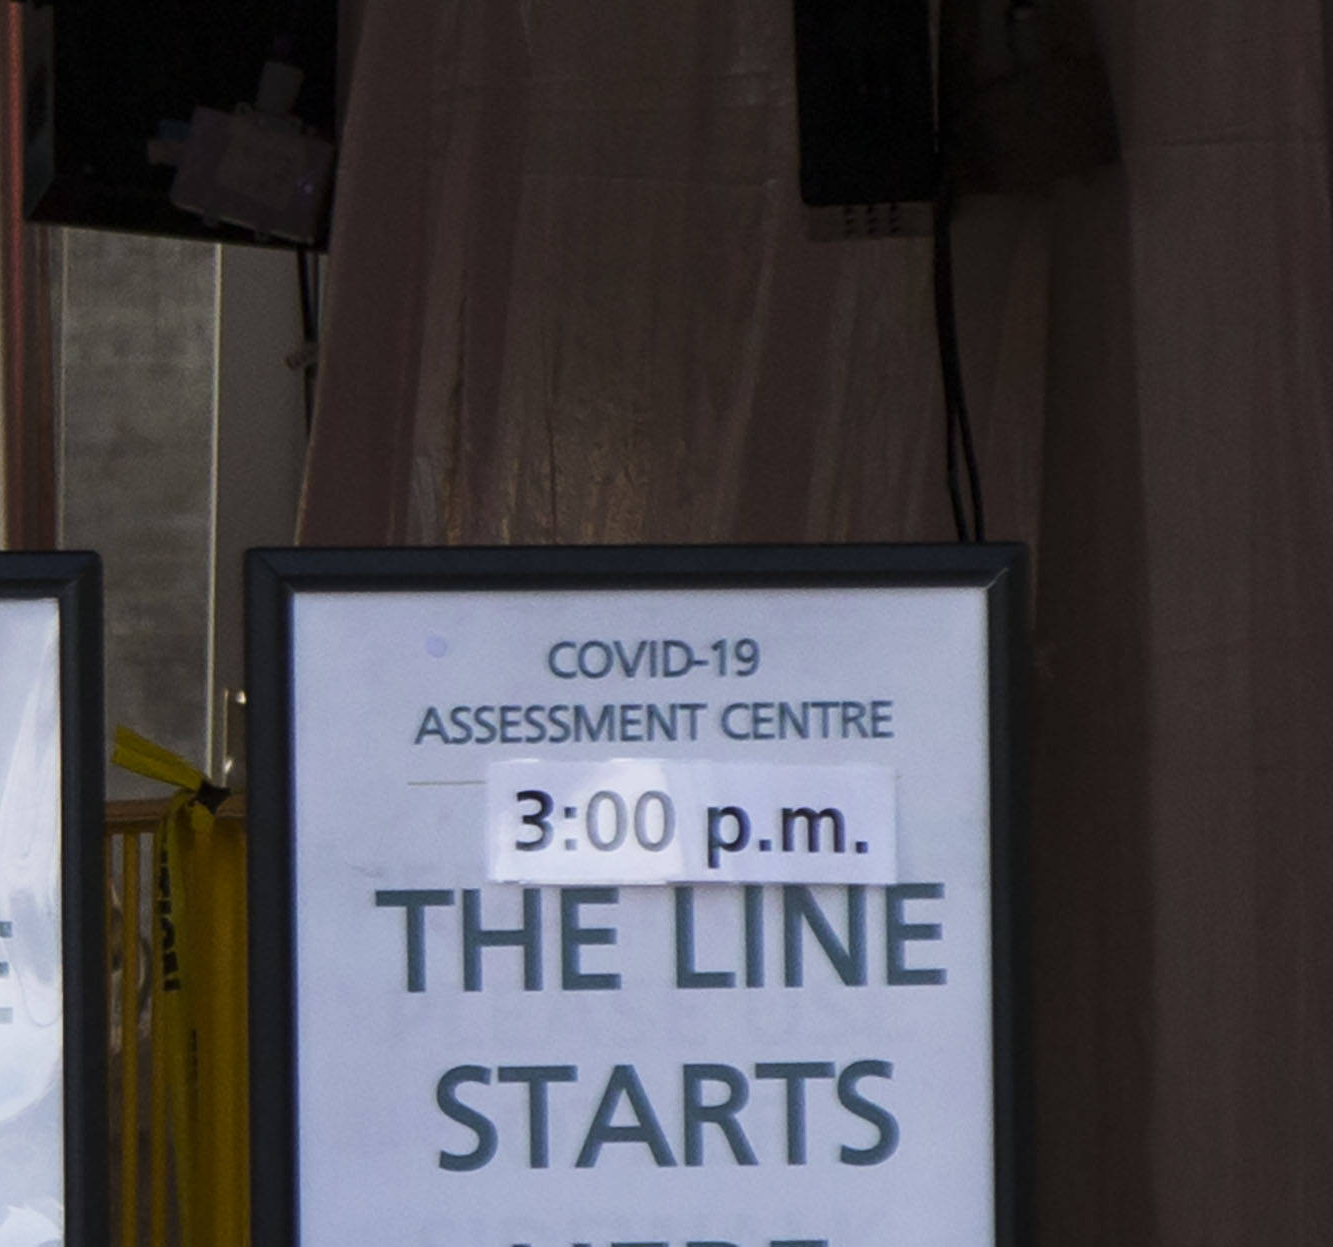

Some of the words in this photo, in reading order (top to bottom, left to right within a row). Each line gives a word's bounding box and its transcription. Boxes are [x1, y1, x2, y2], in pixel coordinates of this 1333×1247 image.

[548, 638, 759, 679] COVID-19
[414, 703, 707, 744] ASSESSMENT
[721, 700, 893, 740] CENTRE
[516, 790, 672, 851] 3:00
[707, 806, 867, 868] p.m.
[374, 886, 622, 993] THE
[672, 883, 947, 989] LINE
[436, 1060, 898, 1172] STARTS
